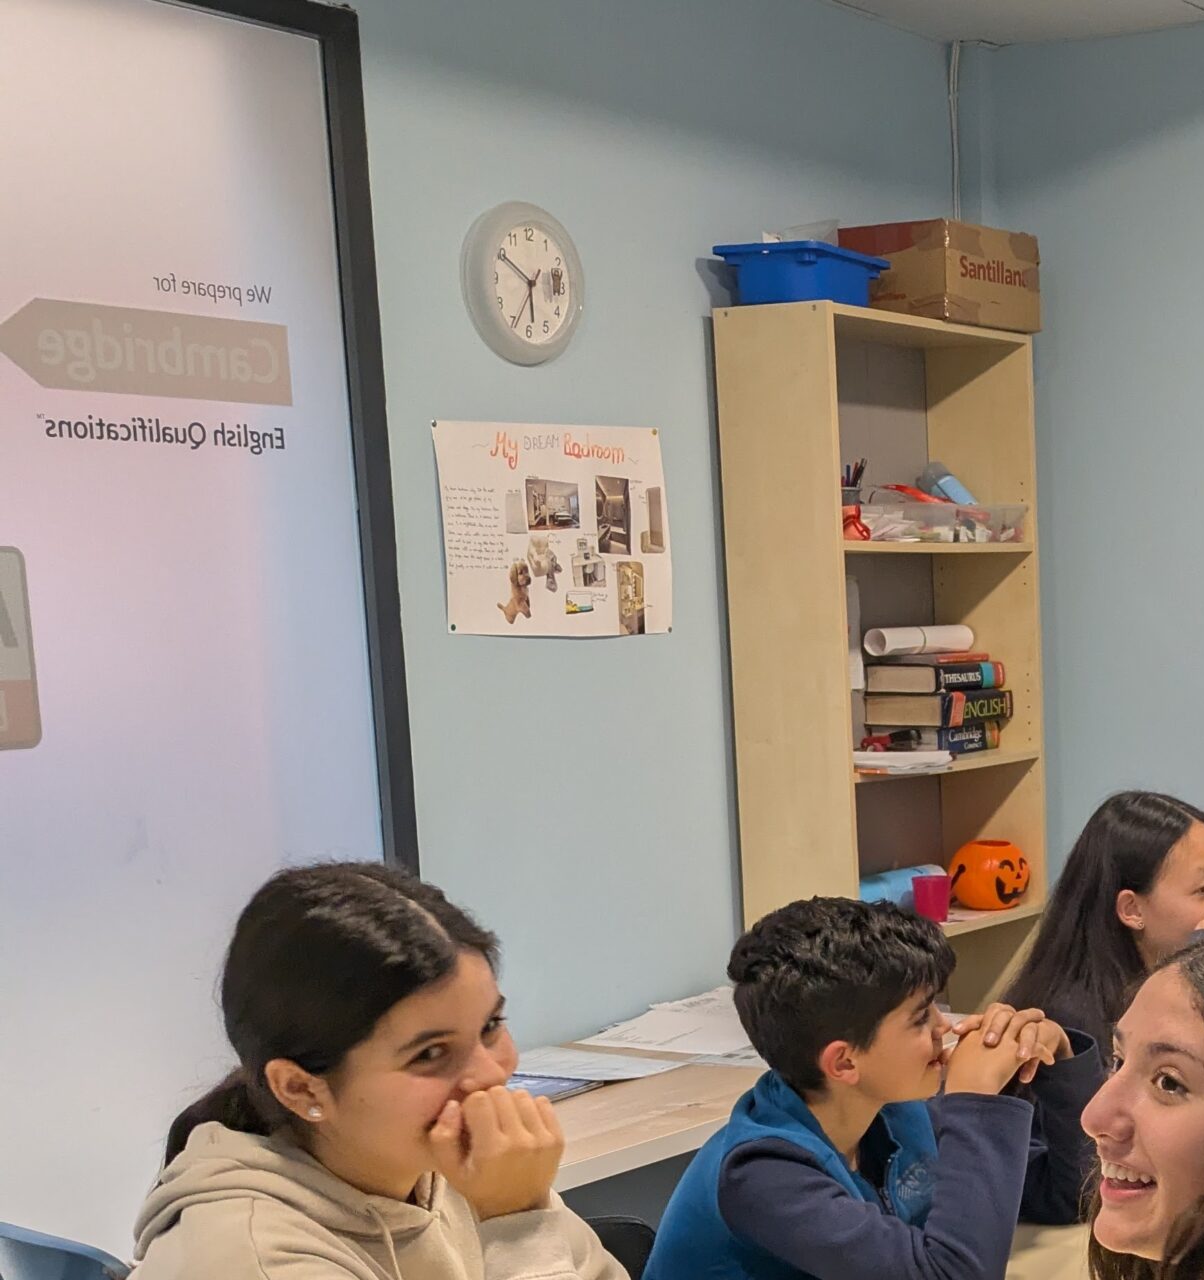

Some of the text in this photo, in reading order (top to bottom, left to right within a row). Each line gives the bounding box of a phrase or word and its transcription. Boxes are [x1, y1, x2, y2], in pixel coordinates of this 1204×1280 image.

[489, 431, 519, 470] My
[523, 434, 561, 451] DREAM
[944, 669, 982, 684] THESAURUS
[963, 698, 1007, 719] ENGLISH
[948, 726, 983, 743] Cambridge
